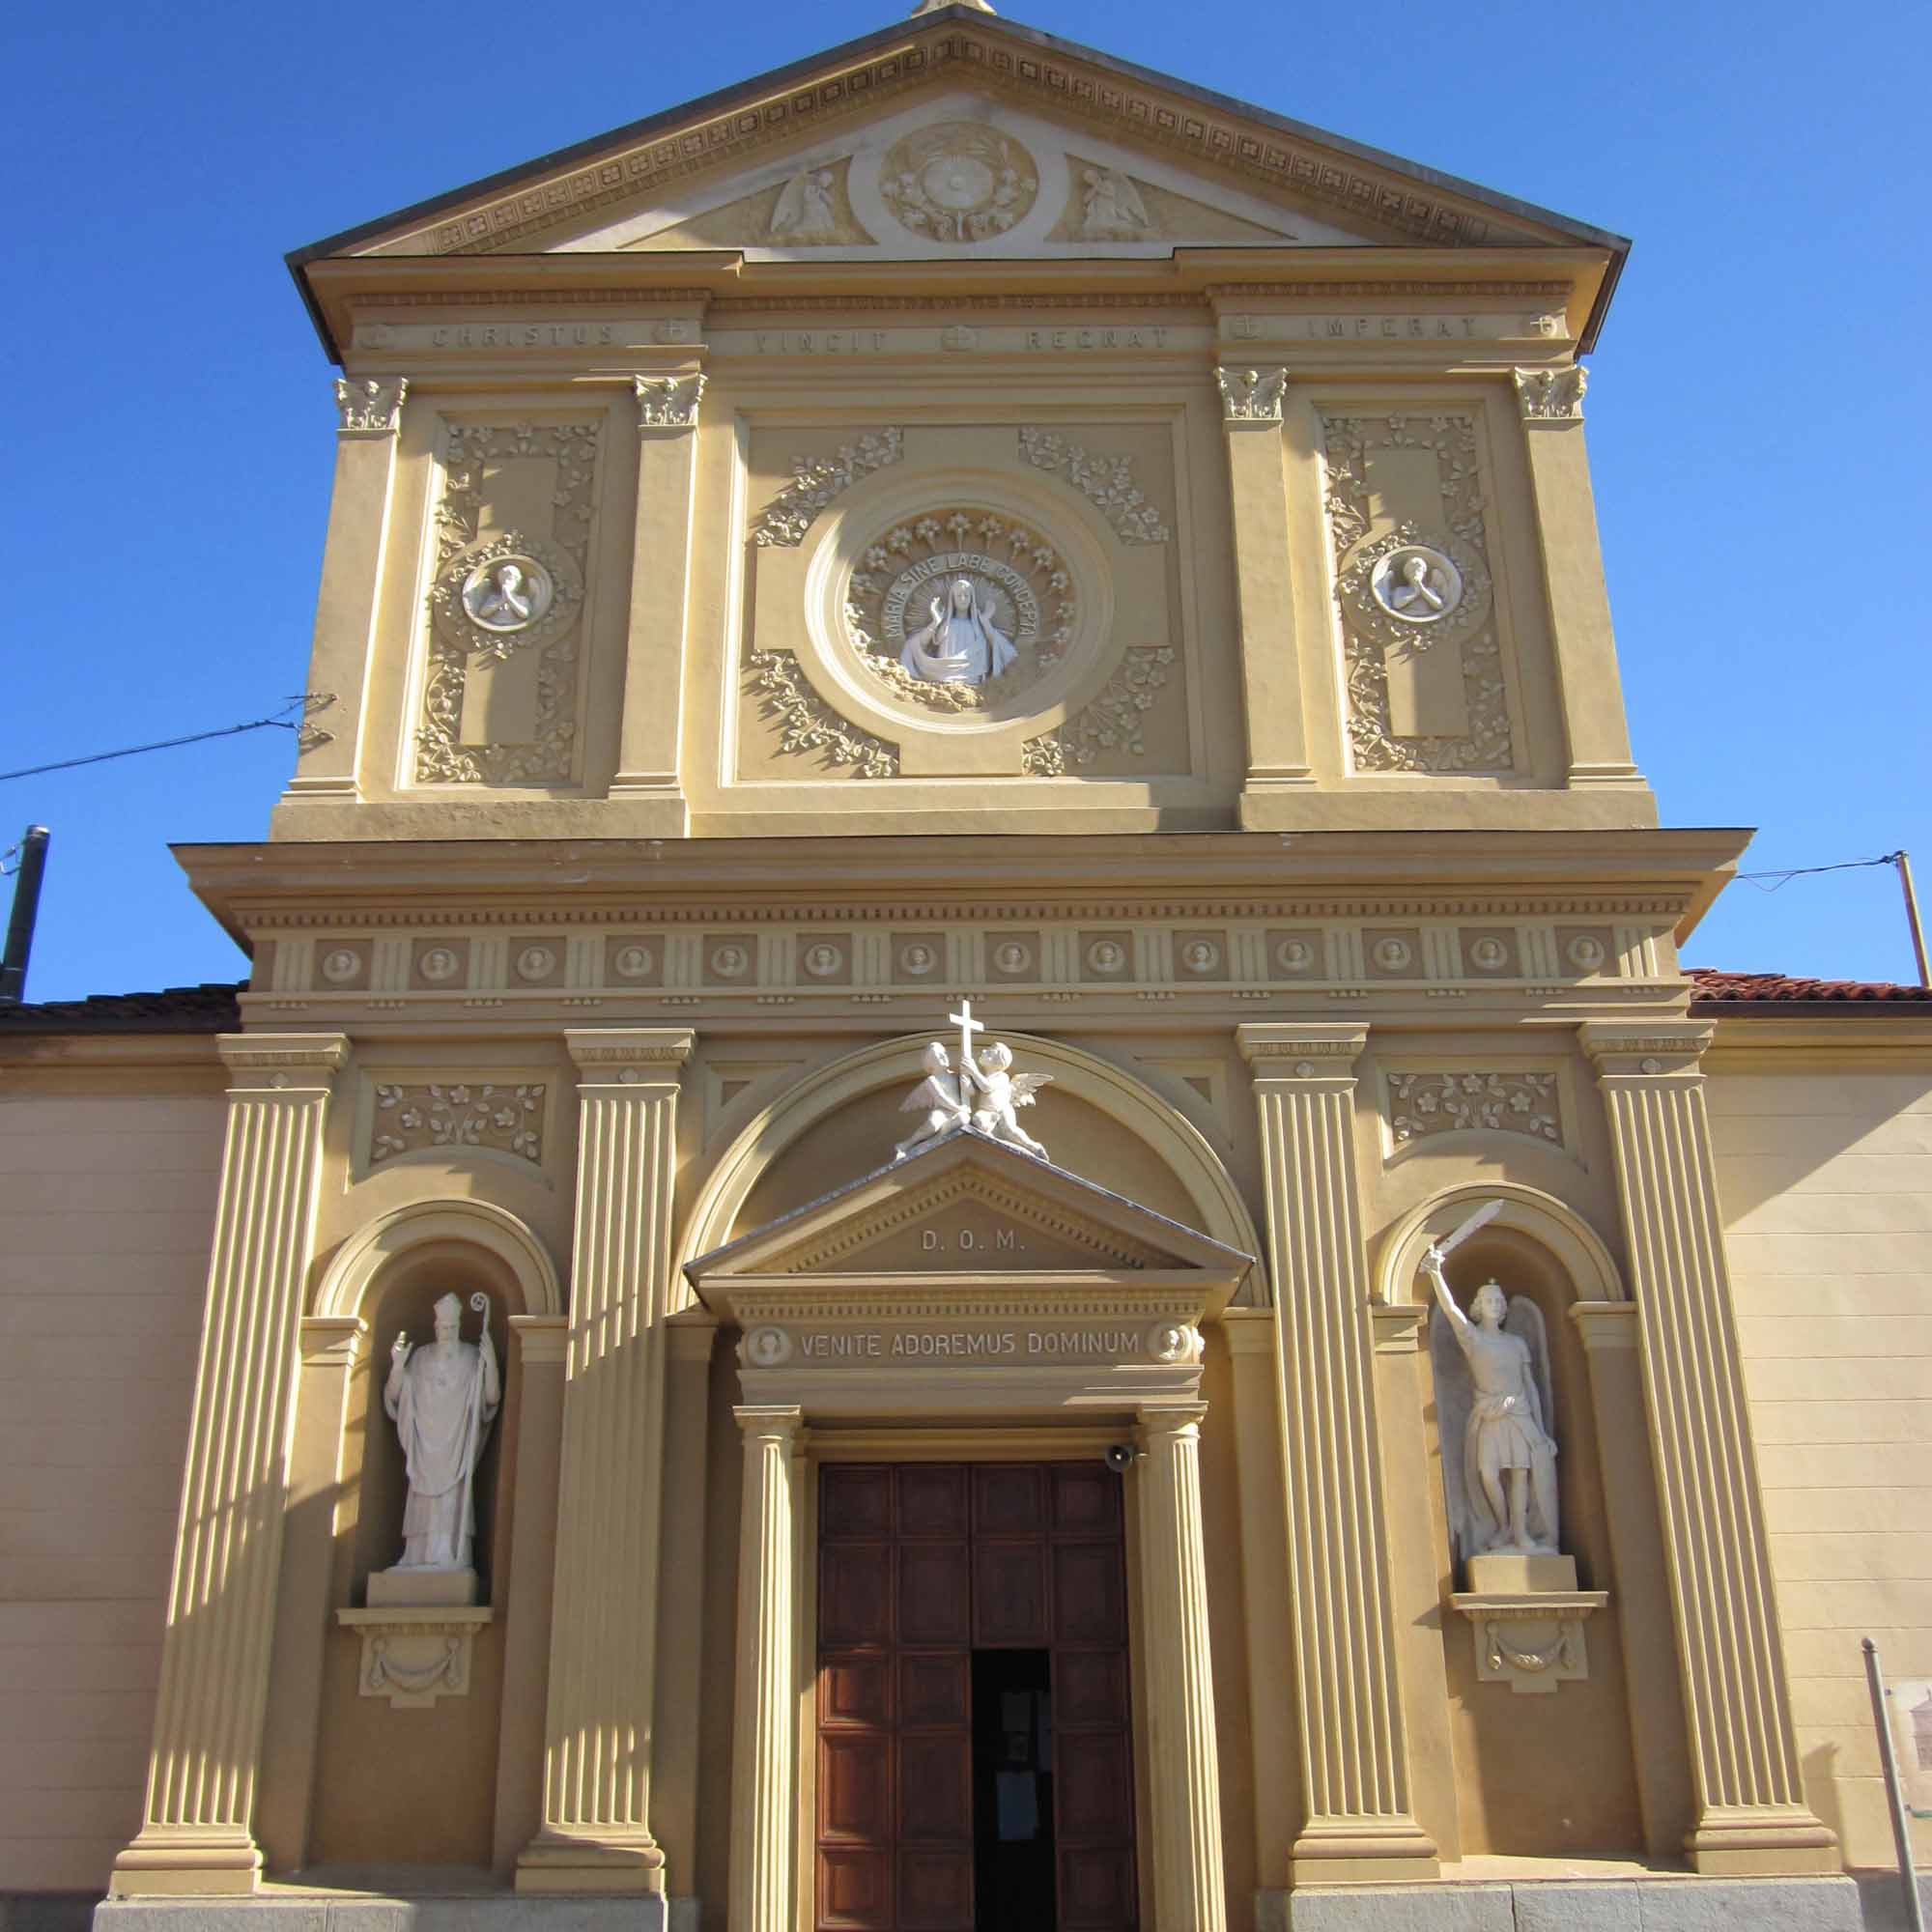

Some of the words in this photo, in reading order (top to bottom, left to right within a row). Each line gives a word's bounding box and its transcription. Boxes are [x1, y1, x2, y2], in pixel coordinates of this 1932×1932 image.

[753, 330, 886, 354] VINCIT
[1305, 317, 1477, 338] IMPERAT
[887, 589, 905, 638] MARIA
[900, 556, 937, 584] SINE
[946, 554, 991, 572] LABE
[801, 1333, 882, 1357] VENITE
[891, 1332, 1016, 1356] ADOREMUS
[1028, 1332, 1140, 1354] DOMINUM
